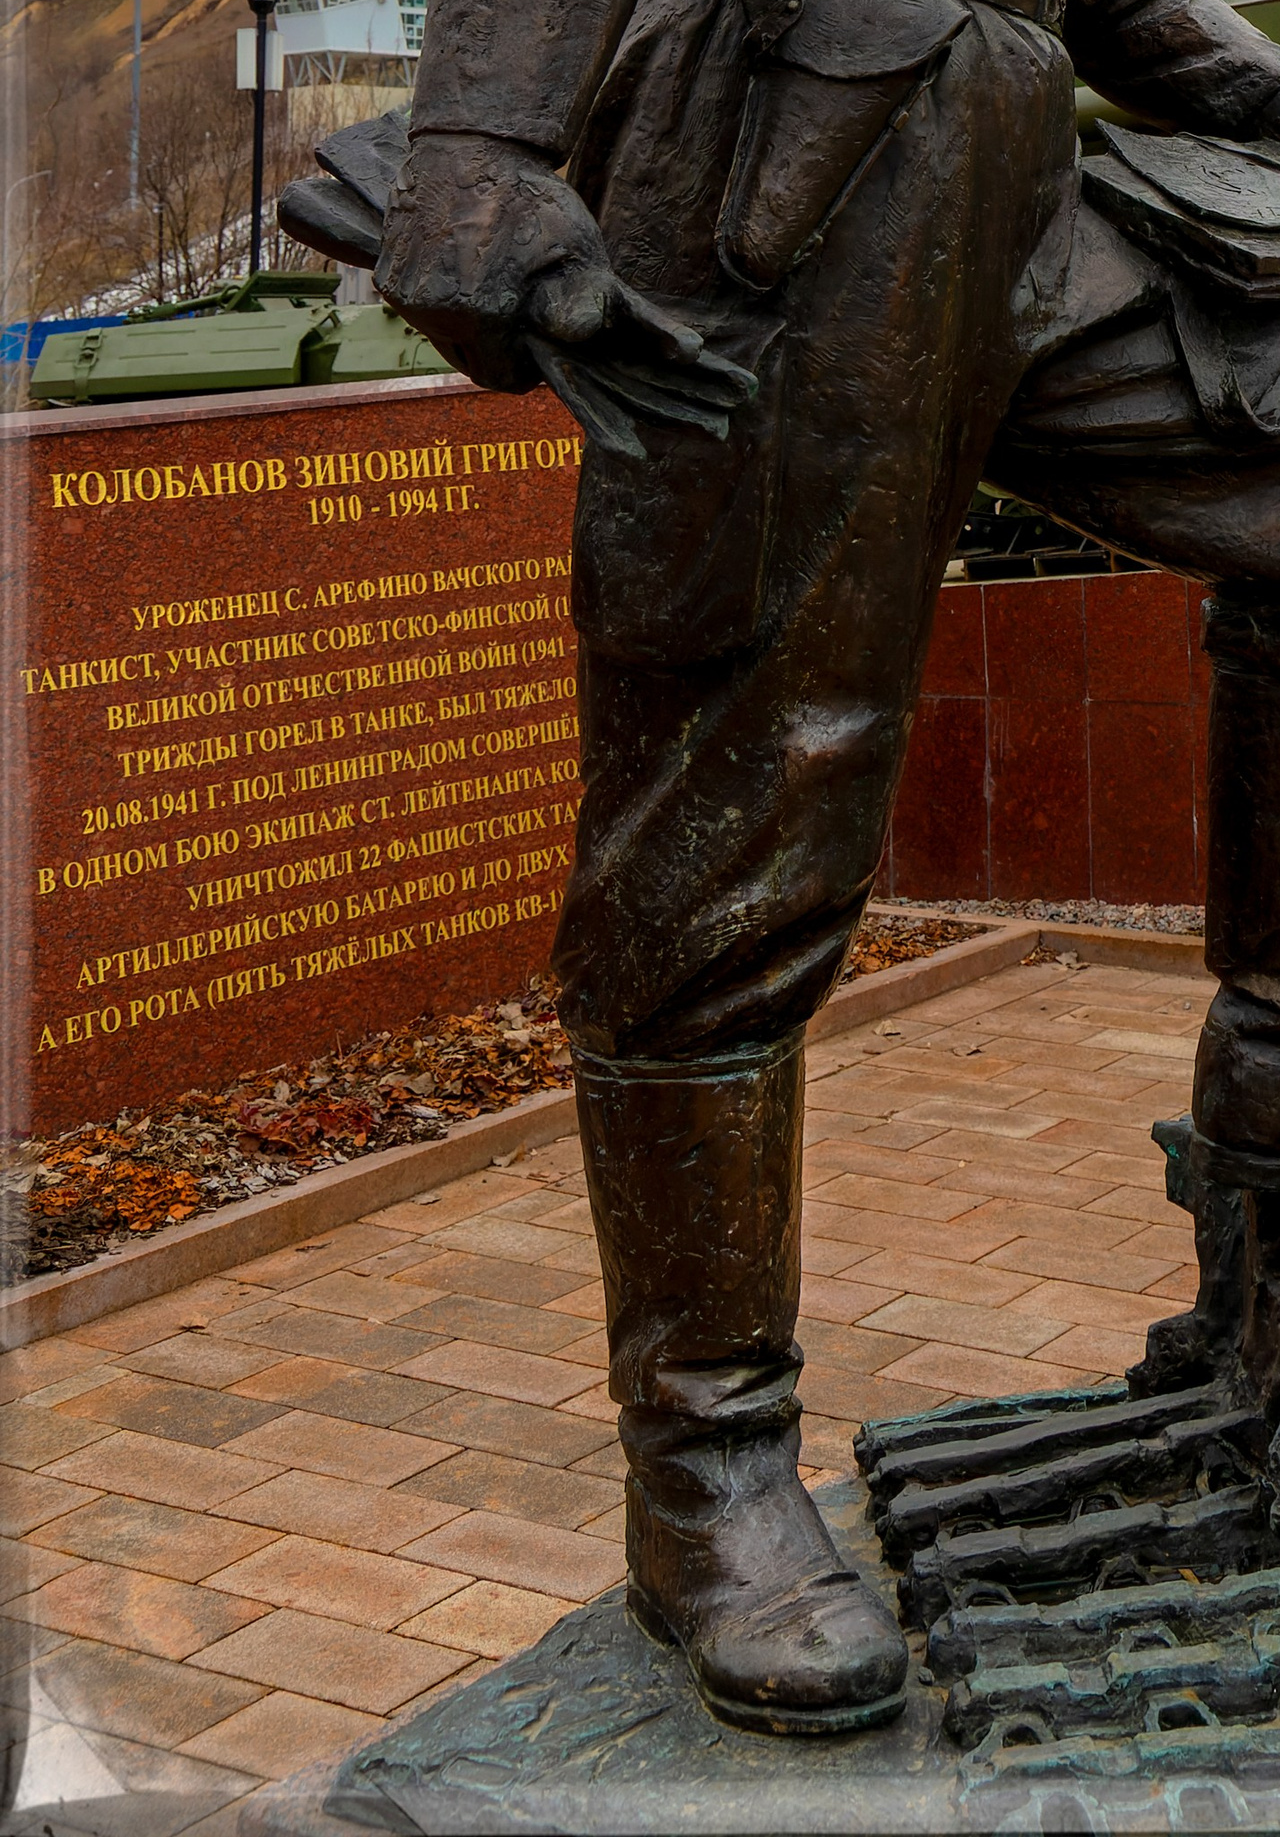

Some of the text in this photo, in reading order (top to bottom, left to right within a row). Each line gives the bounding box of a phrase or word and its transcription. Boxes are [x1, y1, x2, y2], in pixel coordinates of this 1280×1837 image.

[49, 459, 287, 508] КОЛОБАНОВ
[295, 439, 455, 488] ЗИНОВИЙ
[308, 495, 362, 525] 1910
[387, 488, 438, 517] 1994
[444, 485, 479, 511] ГГ.
[20, 653, 160, 694] ТАНКИСТ,
[165, 632, 307, 674] УЧАСТНИК
[313, 593, 550, 652] СОВЕТСКО-ФИНСКОЙ
[131, 590, 280, 631] УРОЖЕНЕЦ
[284, 588, 307, 611] С.
[314, 573, 427, 607] АРЕФИНО
[432, 559, 540, 592] ВАЧСКОГО
[107, 679, 237, 730] ВЕЛИКОЙ
[243, 649, 452, 708] ОТЕЧЕСТВЕННОЙ
[458, 641, 517, 673] ВОЙН
[522, 637, 564, 667] (1941
[118, 677, 576, 777] ТРИЖДЫ ГОРЕЛ В ТАНКЕ, БЫЛ ТЯЖЕЛО
[37, 759, 579, 895] В ОДНОМ БОЮ ЭКИПАЖ СТ. ЛЕЙТЕНАНТА КО
[82, 788, 198, 839] 20.08.1941
[206, 784, 226, 809] Г.
[232, 772, 286, 804] ПОД
[291, 738, 467, 792] ЛЕНИНГРАДОМ
[186, 798, 582, 911] УНИЧТОЖИЛ 22 ФАШИСТСКИХ ТА
[76, 844, 569, 989] АРТИЛЛЕРИЙСКУЮ БАТАРЕЮ И ДО ДВУХ
[37, 1025, 57, 1052] А
[65, 1006, 121, 1044] ЕГО
[128, 986, 200, 1027] РОТА
[207, 963, 285, 1009] (ПЯТЬ
[291, 926, 416, 980] ТЯЖЁЛЫХ
[421, 903, 510, 945] ТАНКОВ
